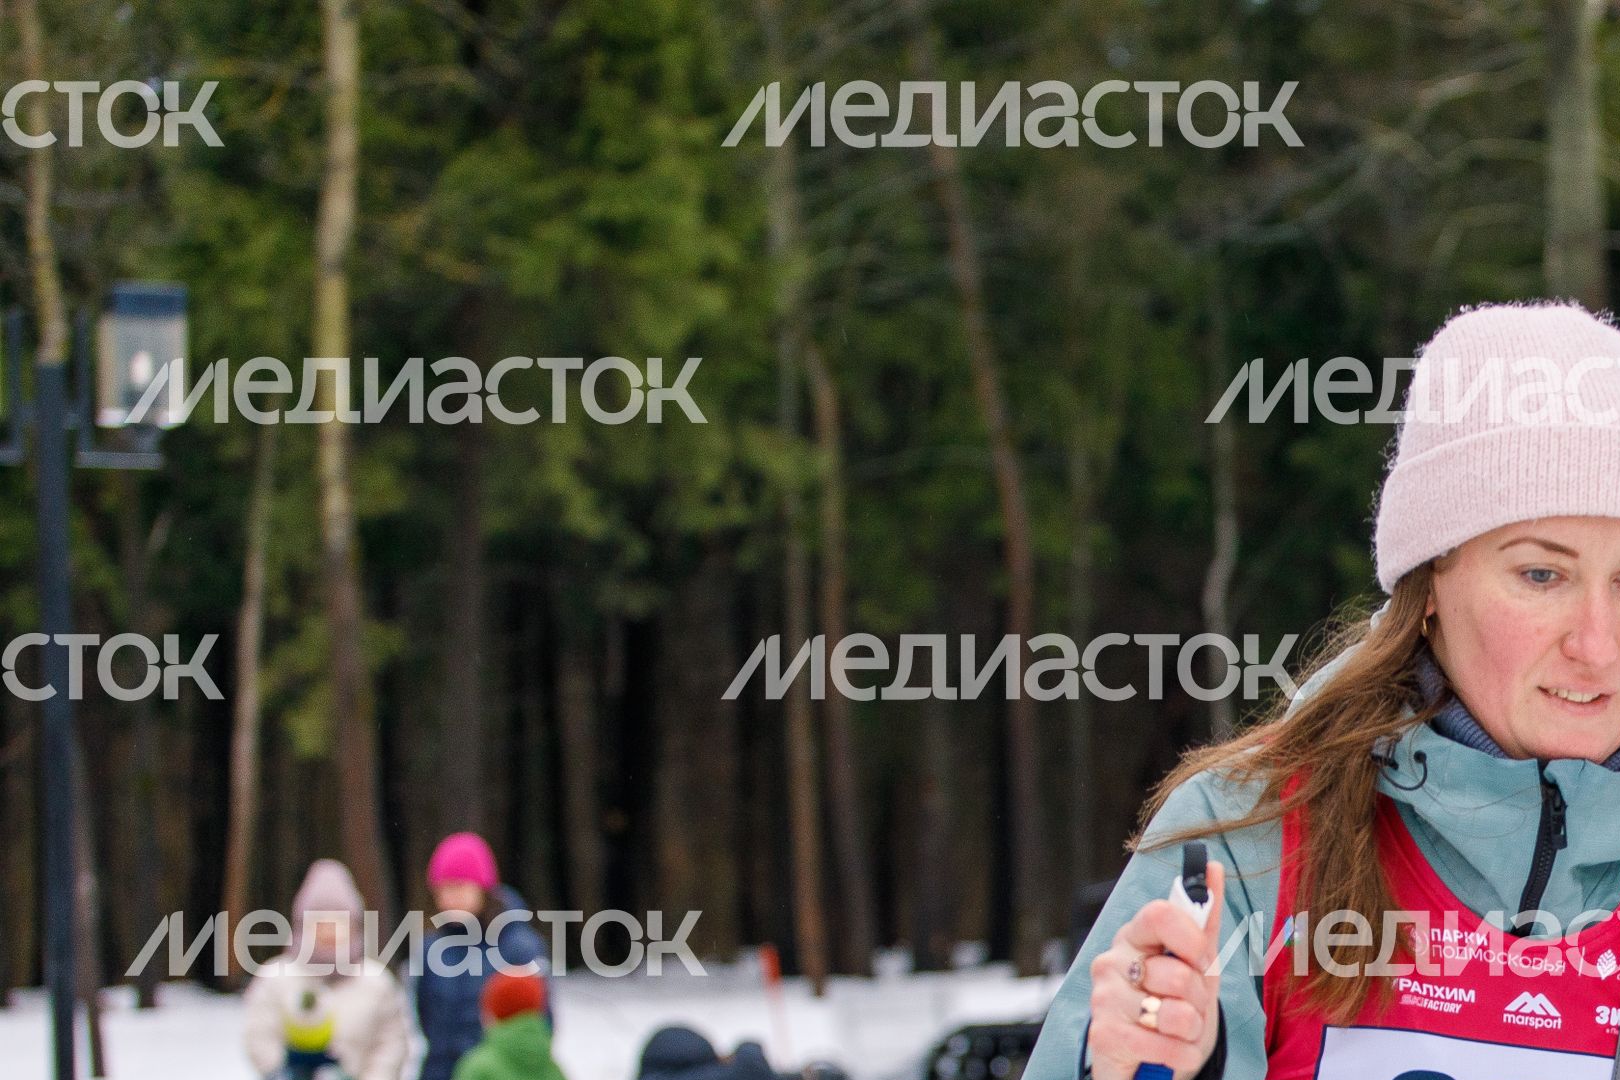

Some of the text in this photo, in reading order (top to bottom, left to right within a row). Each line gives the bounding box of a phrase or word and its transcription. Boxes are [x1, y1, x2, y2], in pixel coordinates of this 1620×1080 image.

[1430, 927, 1489, 947] ПАРКИ
[1392, 977, 1477, 1004] РАЛХИМ
[1502, 1012, 1562, 1030] marsport
